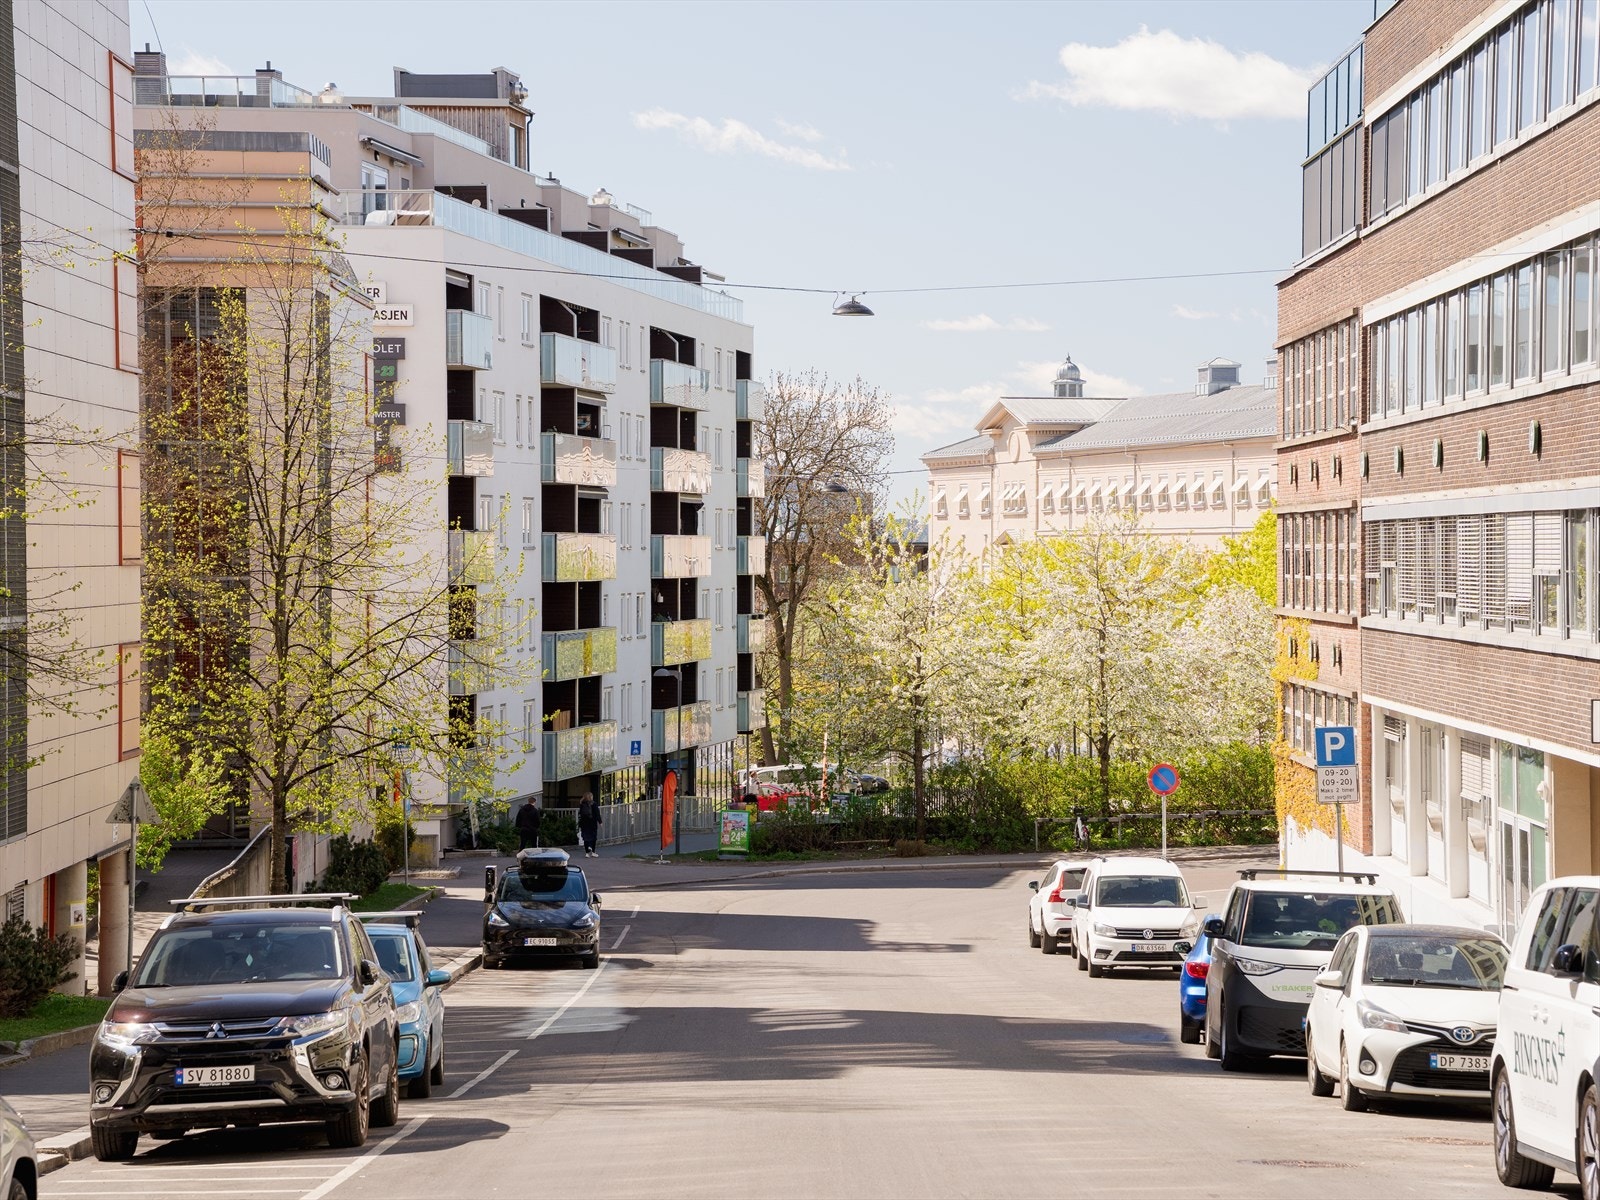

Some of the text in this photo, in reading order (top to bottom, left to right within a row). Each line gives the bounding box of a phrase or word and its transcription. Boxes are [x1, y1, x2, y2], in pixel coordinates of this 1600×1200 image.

[1324, 732, 1346, 762] P
[1440, 1056, 1491, 1069] DP 7383
[1513, 1031, 1559, 1086] RINGNES
[188, 1067, 250, 1082] SV 81880
